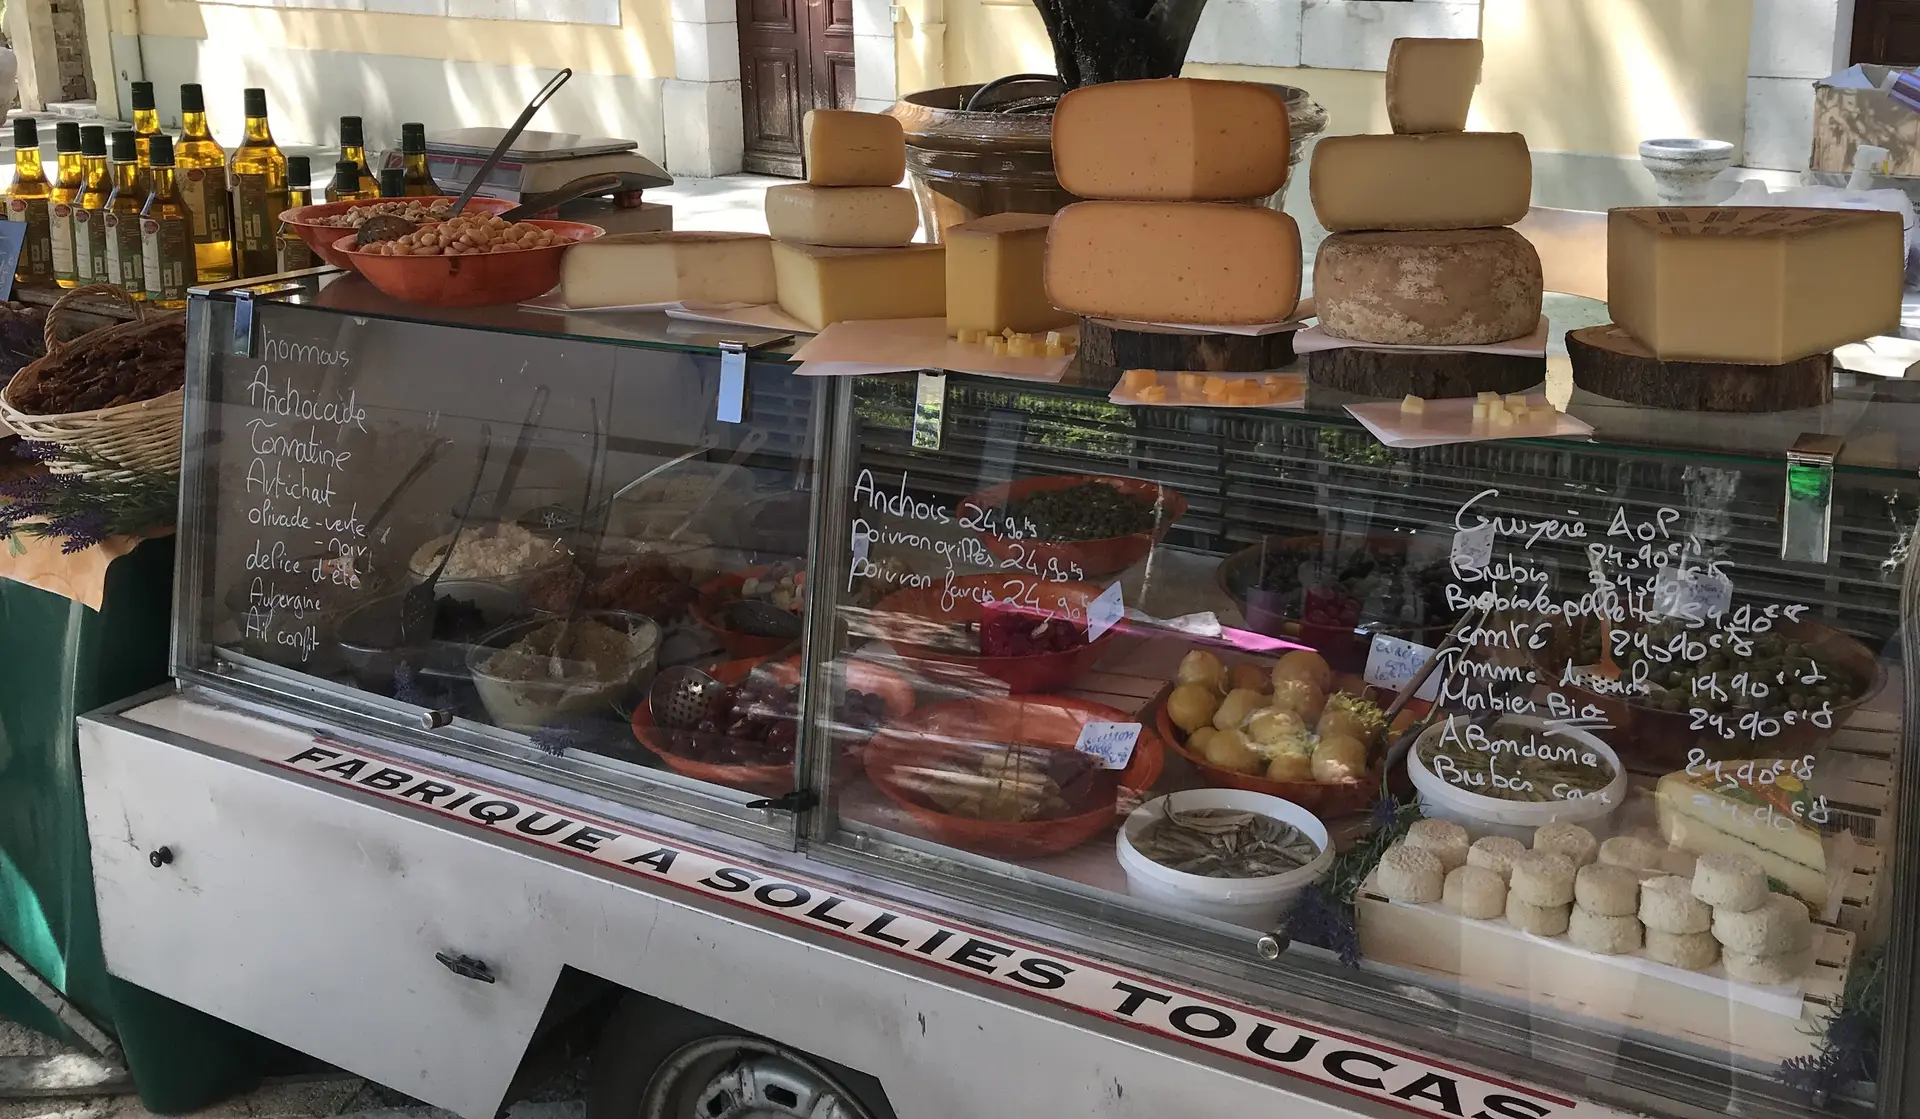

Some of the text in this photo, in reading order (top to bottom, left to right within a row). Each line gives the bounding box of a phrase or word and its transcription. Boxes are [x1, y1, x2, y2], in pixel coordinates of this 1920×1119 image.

[854, 468, 950, 524] Anchois
[1451, 553, 1549, 583] Brebis
[1546, 692, 1607, 719] Bio
[284, 745, 1552, 1119] FABRIQUE A SOLLIES TOUCAS
